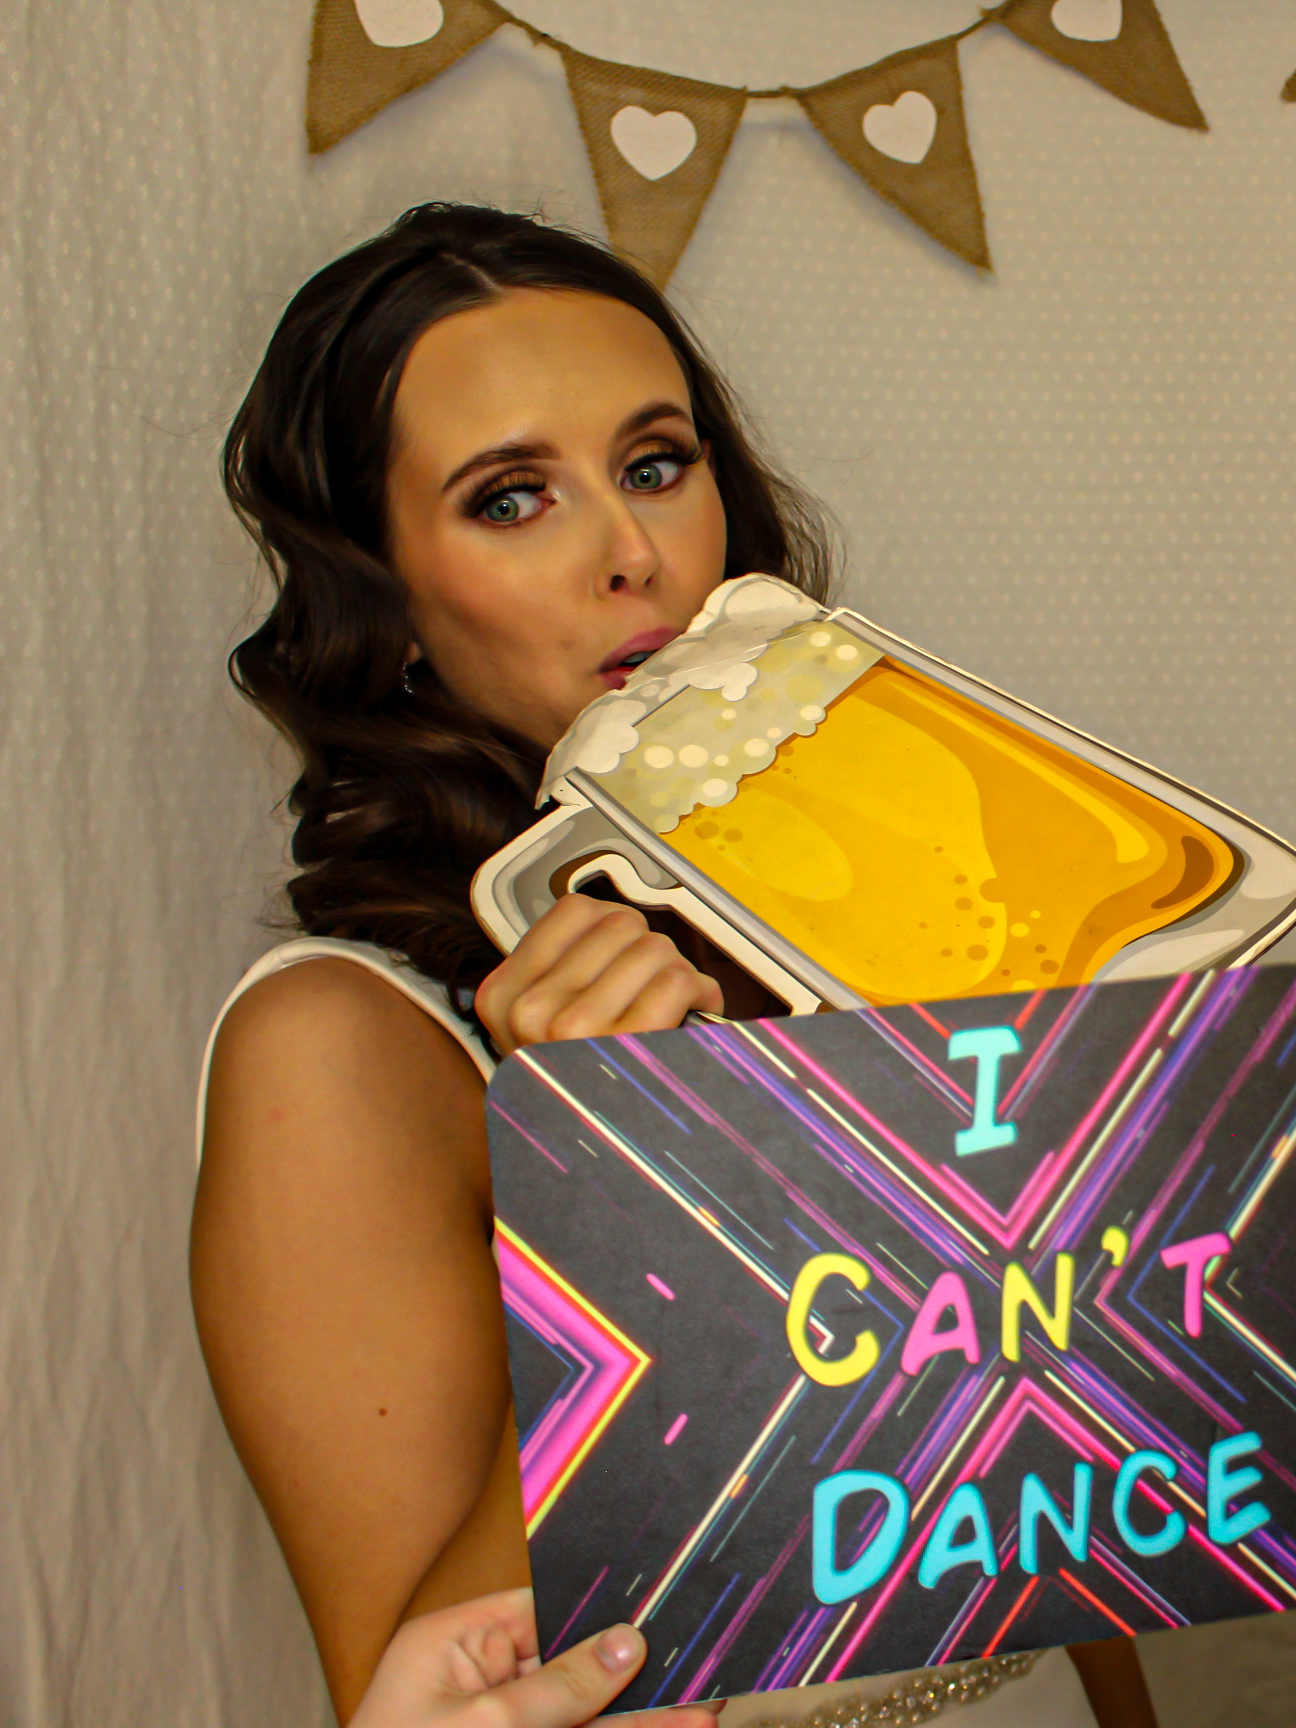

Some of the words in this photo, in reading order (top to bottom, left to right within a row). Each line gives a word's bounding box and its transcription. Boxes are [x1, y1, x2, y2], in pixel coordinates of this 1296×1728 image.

[948, 1026, 1022, 1156] I
[786, 1226, 1232, 1387] CAN'T
[812, 1432, 1271, 1605] DANCE
